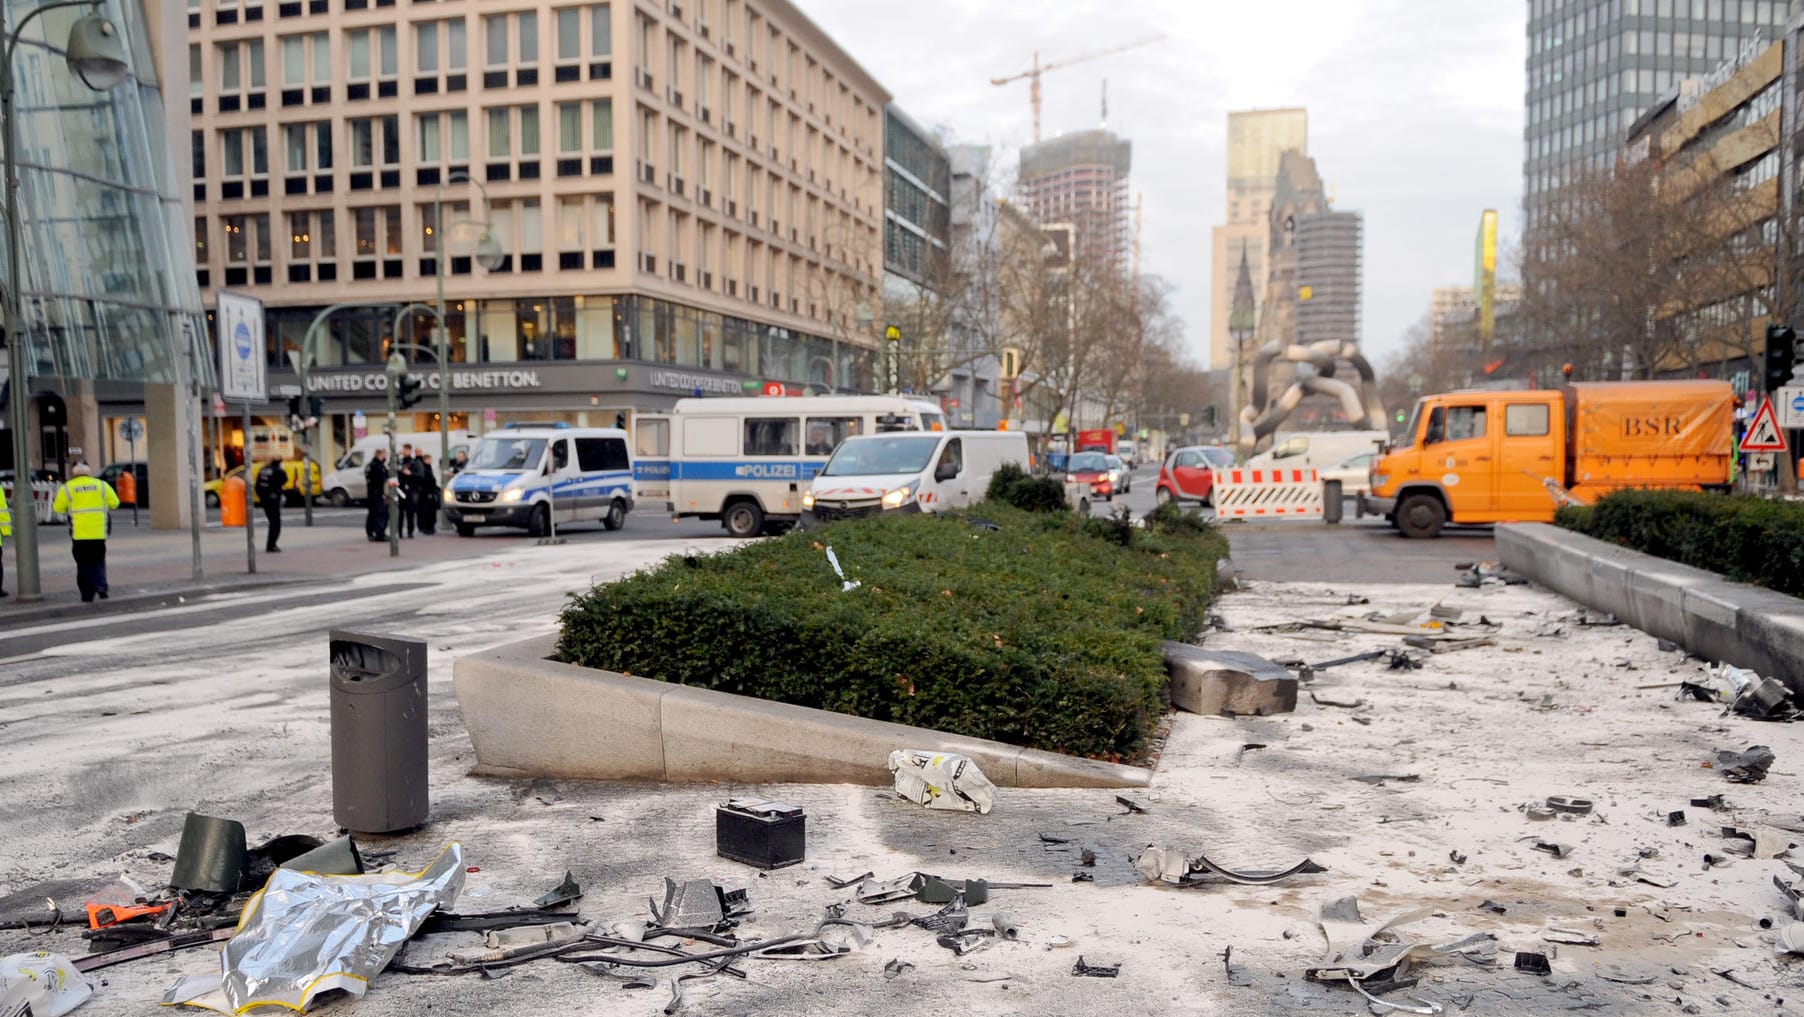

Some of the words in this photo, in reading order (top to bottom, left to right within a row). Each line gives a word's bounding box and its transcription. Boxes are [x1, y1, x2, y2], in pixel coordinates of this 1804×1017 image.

[306, 374, 362, 391] UNITED
[365, 373, 425, 391] COS
[428, 372, 448, 390] O
[1624, 416, 1681, 436] BSR
[745, 464, 796, 477] POLIZEI
